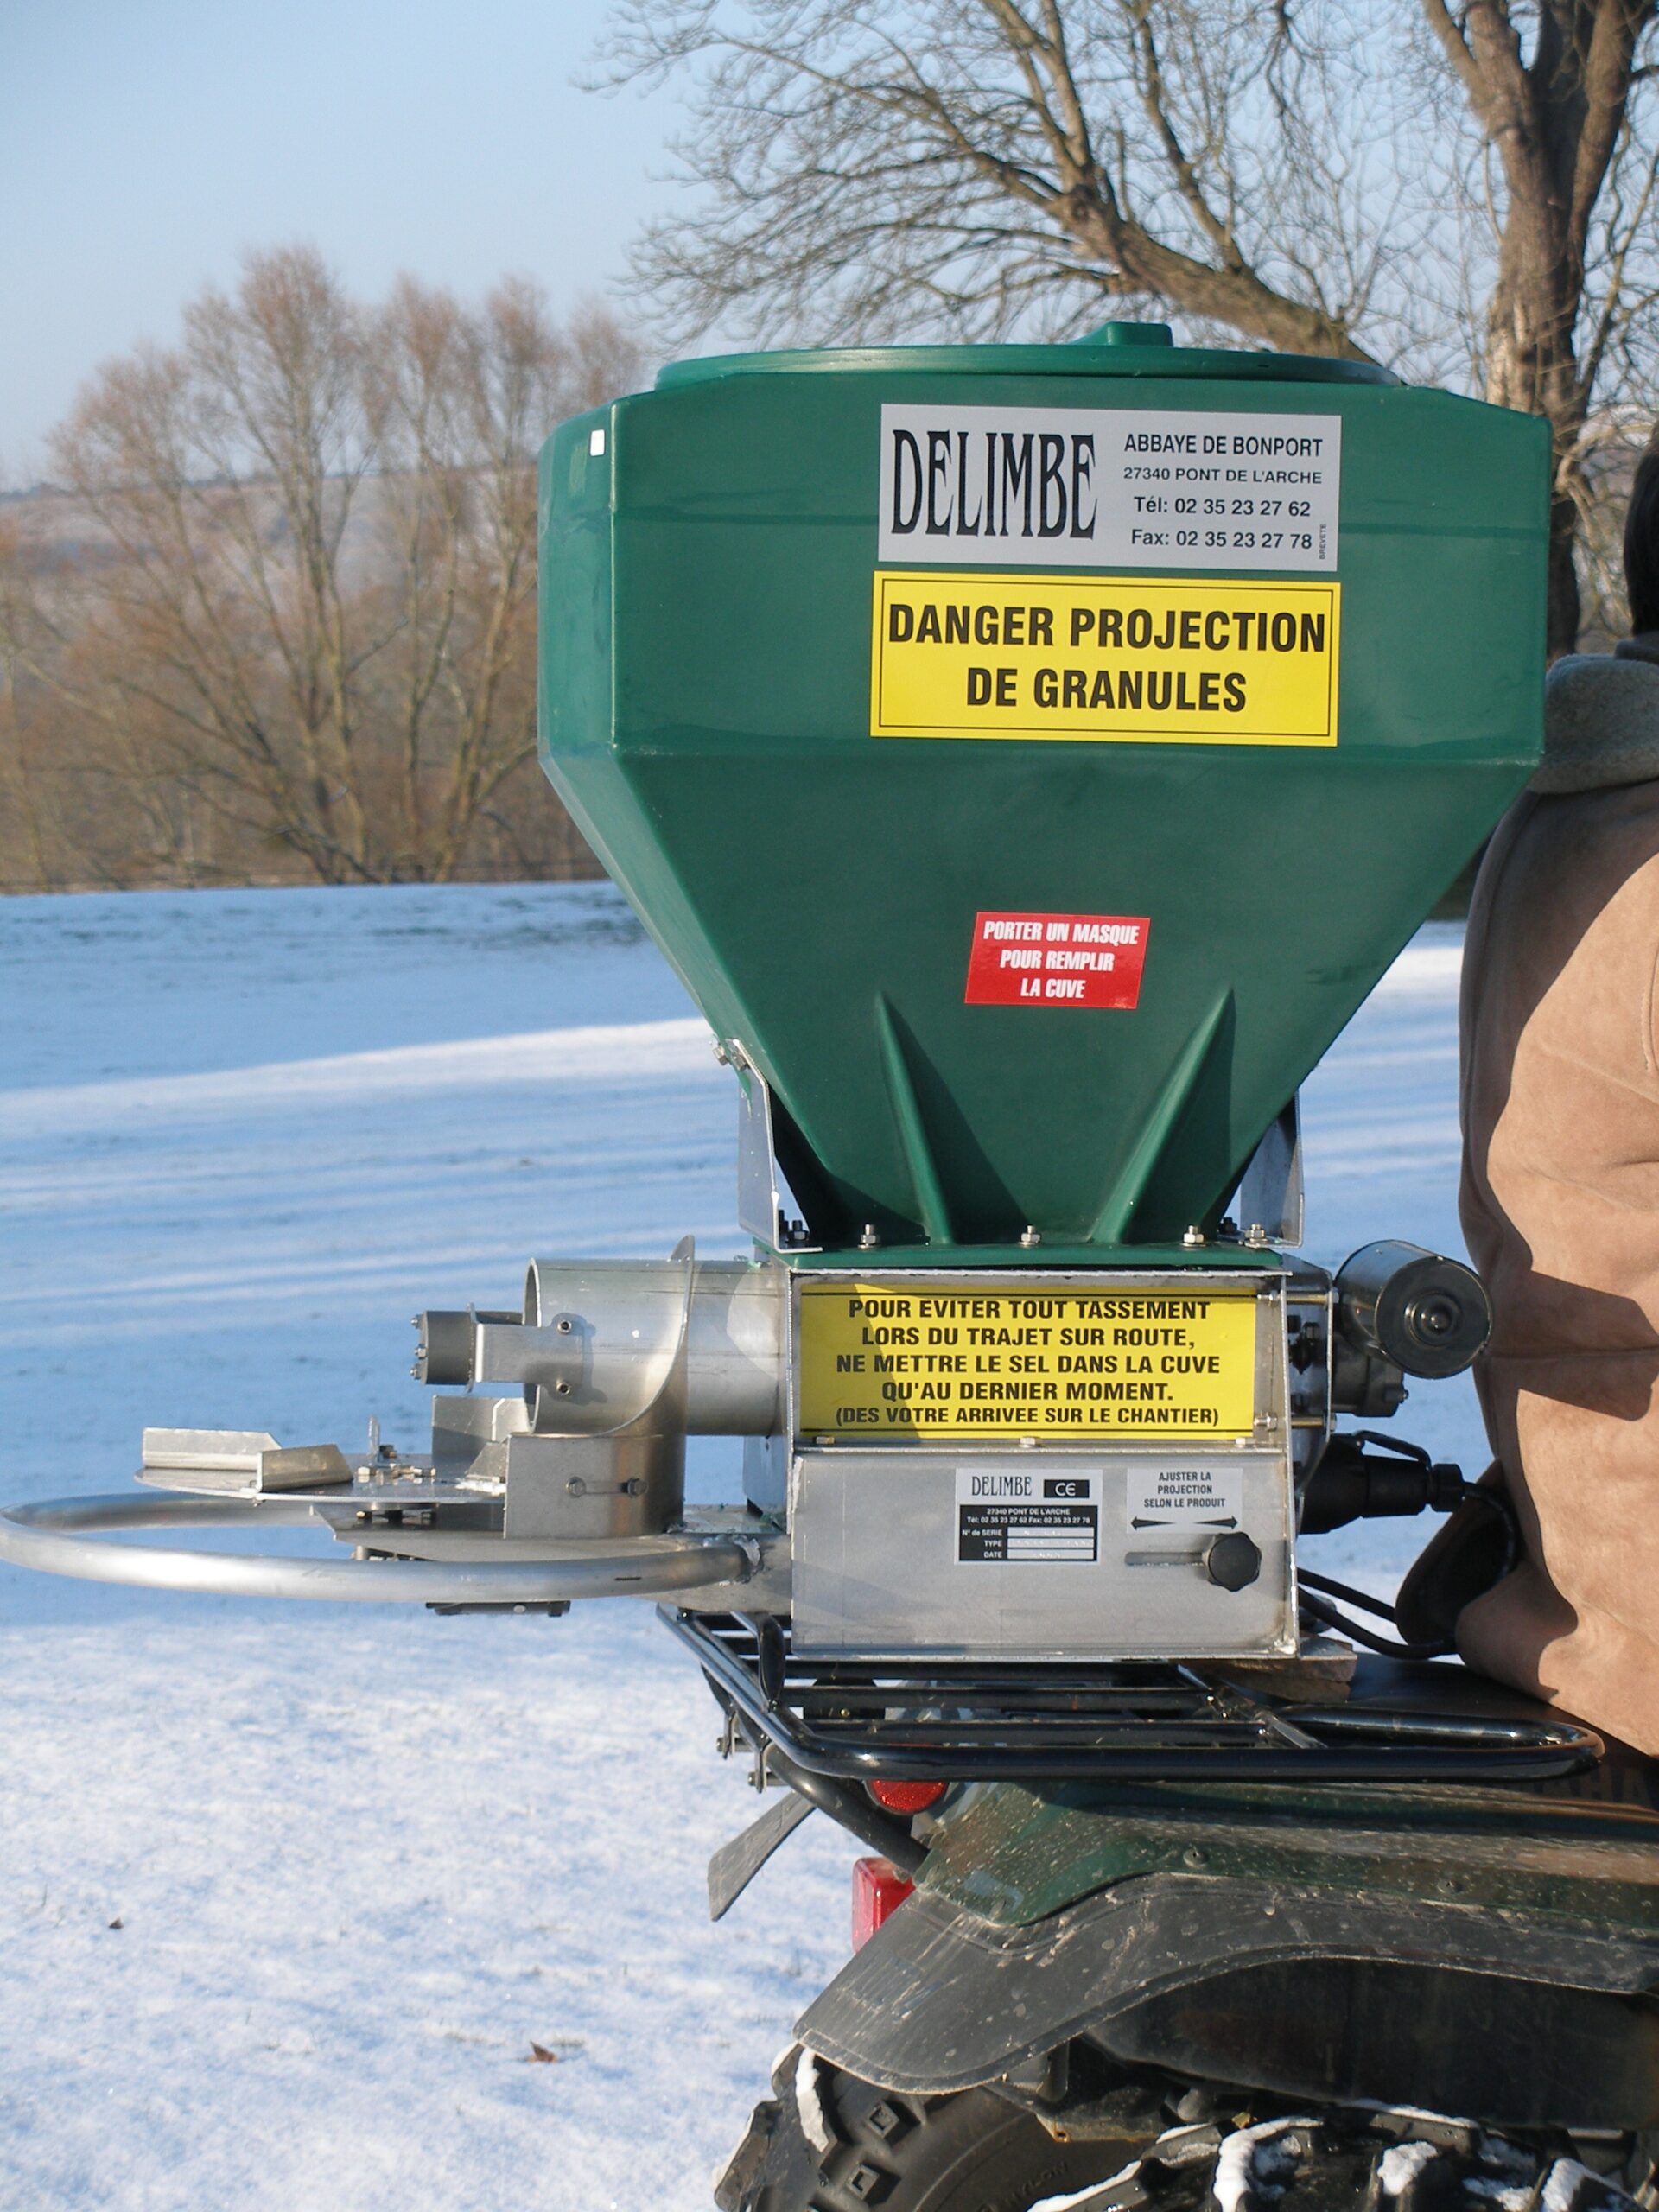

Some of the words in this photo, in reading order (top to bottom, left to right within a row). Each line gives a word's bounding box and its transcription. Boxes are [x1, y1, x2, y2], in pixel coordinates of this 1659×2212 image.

[1124, 434, 1196, 454] ABBAYE
[1204, 436, 1226, 454] DE
[1233, 437, 1323, 456] BONPORT
[891, 429, 1097, 540] DELIMBE
[1123, 467, 1170, 480] 27340
[1175, 468, 1220, 481] PONT
[1226, 470, 1247, 482] DE
[1253, 471, 1322, 484] L'ARCHE
[1135, 496, 1167, 512] Tél:
[1175, 499, 1197, 513] 02
[1204, 499, 1225, 514] 35
[1231, 500, 1253, 515] 23
[1261, 501, 1282, 516] 27
[1288, 501, 1310, 516] 62
[1132, 529, 1169, 545] Fax:
[1176, 531, 1198, 546] 02
[1205, 532, 1226, 547] 35
[1233, 532, 1255, 547] 23
[1262, 533, 1283, 548] 27
[1290, 534, 1312, 549] 78
[888, 604, 1054, 645] DANGER
[1071, 608, 1325, 652] PROJECTION
[967, 668, 1018, 706] DE
[1033, 670, 1247, 712] GRANULES
[983, 921, 1043, 940] PORTER
[1046, 923, 1070, 941] UN
[1072, 924, 1139, 946] MASQUE
[1000, 950, 1042, 969] POUR
[1046, 951, 1115, 971] REMPLIR
[1020, 978, 1040, 997] LA
[1046, 979, 1086, 998] CUVE
[849, 1300, 911, 1318] POUR
[919, 1301, 1001, 1318] EVITER
[1008, 1301, 1066, 1319] TOUT
[1076, 1302, 1211, 1319] TASSEMENT
[861, 1327, 918, 1345] LORS
[929, 1328, 959, 1345] DU
[967, 1328, 1053, 1346] TRAJET
[1060, 1328, 1108, 1346] SUR
[1114, 1329, 1195, 1349] ROUTE,
[836, 1355, 866, 1372] NE
[874, 1355, 966, 1373] METTRE
[976, 1356, 1001, 1373] LE
[1009, 1356, 1050, 1373] SEL
[1058, 1356, 1118, 1374] DANS
[1126, 1356, 1154, 1374] LA
[1161, 1356, 1220, 1374] CUVE
[882, 1382, 951, 1402] QU'AU
[960, 1382, 1058, 1400] DERNIER
[1066, 1383, 1173, 1401] MOMENT.
[836, 1407, 880, 1426] (DES
[887, 1408, 950, 1423] VOTRE
[956, 1408, 1039, 1423] ARRIVEE
[1046, 1408, 1083, 1424] SUR
[1090, 1408, 1110, 1424] LE
[1117, 1408, 1218, 1427] CHANTIER)
[972, 1476, 1032, 1496] DELIMBE
[1159, 1472, 1198, 1481] AJUSTER
[1201, 1472, 1211, 1481] LA
[1158, 1485, 1212, 1494] PROJECTION
[1144, 1498, 1172, 1508] SELON
[1174, 1498, 1184, 1507] LE
[1187, 1498, 1225, 1507] PRODUIT
